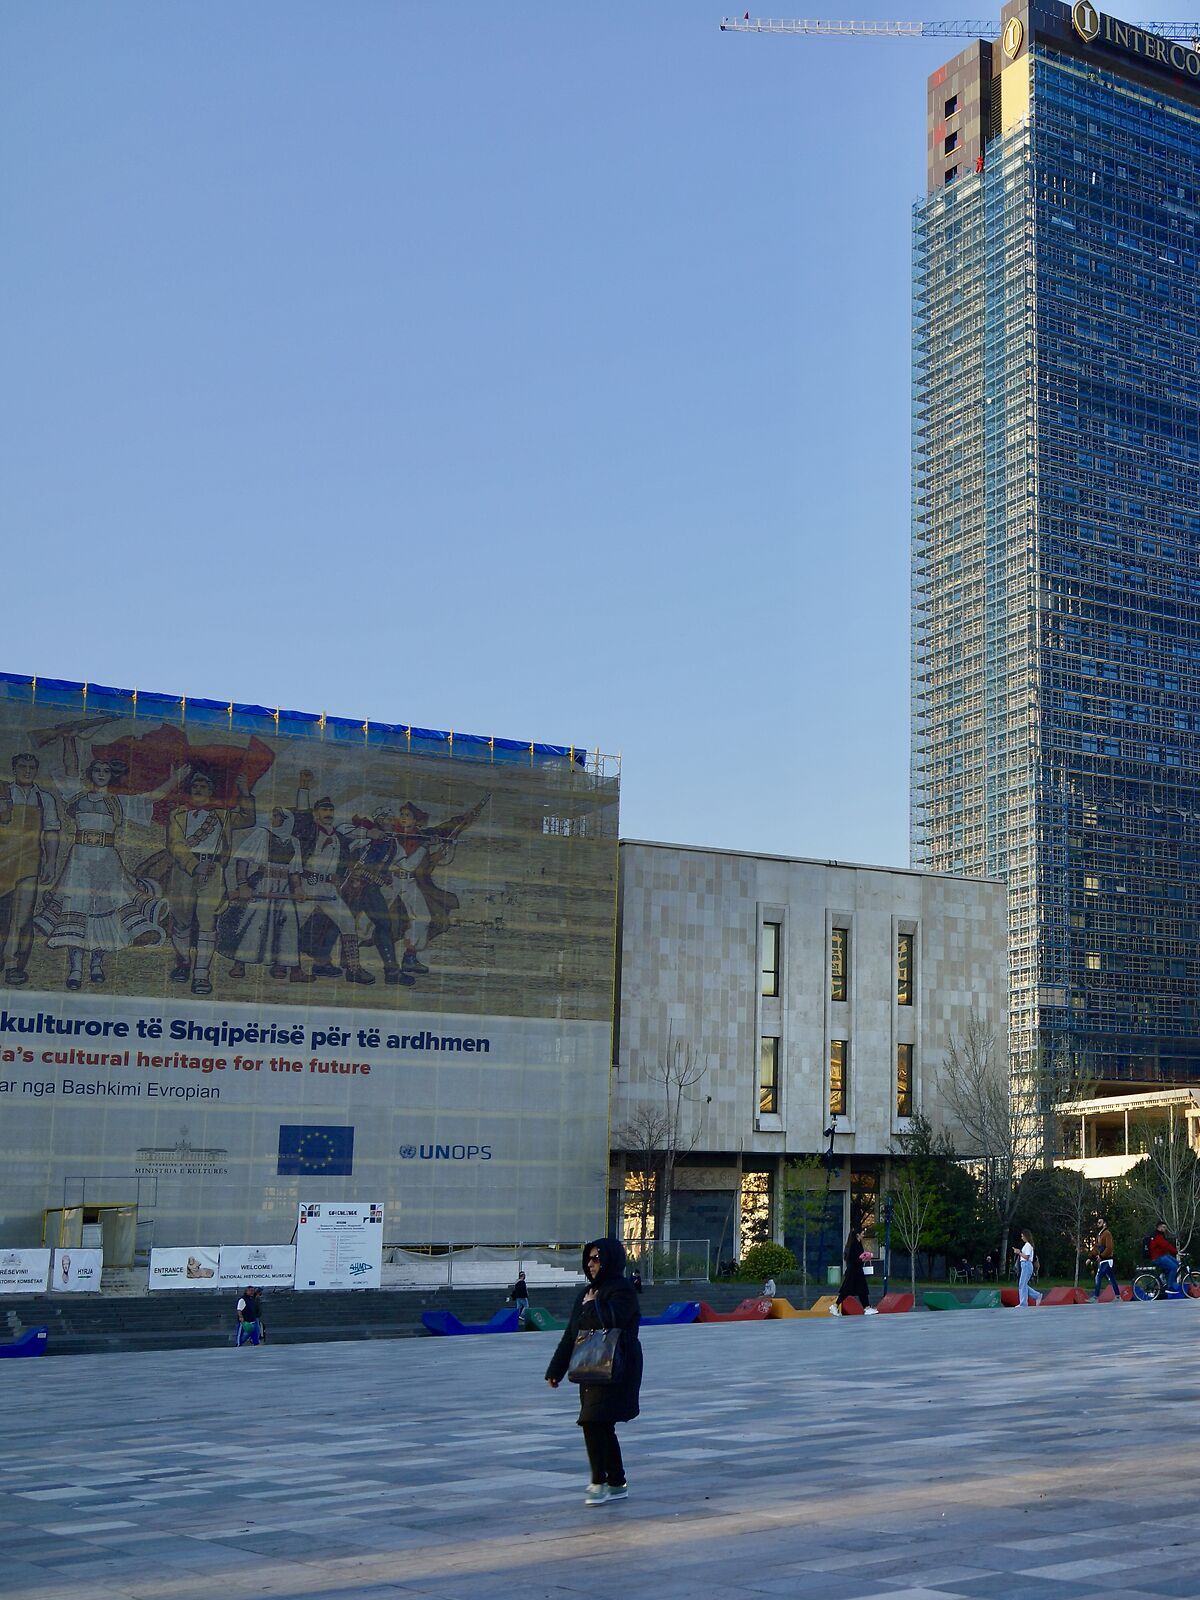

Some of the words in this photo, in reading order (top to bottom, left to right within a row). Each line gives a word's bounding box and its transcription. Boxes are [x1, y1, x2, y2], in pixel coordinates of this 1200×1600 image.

[1, 1011, 129, 1038] kulturore
[136, 1018, 162, 1039] të
[169, 1018, 305, 1047] Shqipërisë
[311, 1026, 351, 1051] për
[357, 1028, 381, 1048] të
[386, 1031, 490, 1052] ardhmen
[0, 1045, 34, 1063] a’s
[41, 1049, 130, 1067] cultural
[137, 1052, 227, 1074] heritage
[233, 1056, 264, 1071] for
[270, 1057, 303, 1073] the
[309, 1058, 371, 1075] future
[23, 1081, 55, 1097] nga
[62, 1079, 141, 1096] Bashkimi
[147, 1083, 220, 1101] Evropian
[420, 1144, 492, 1160] UNOPS
